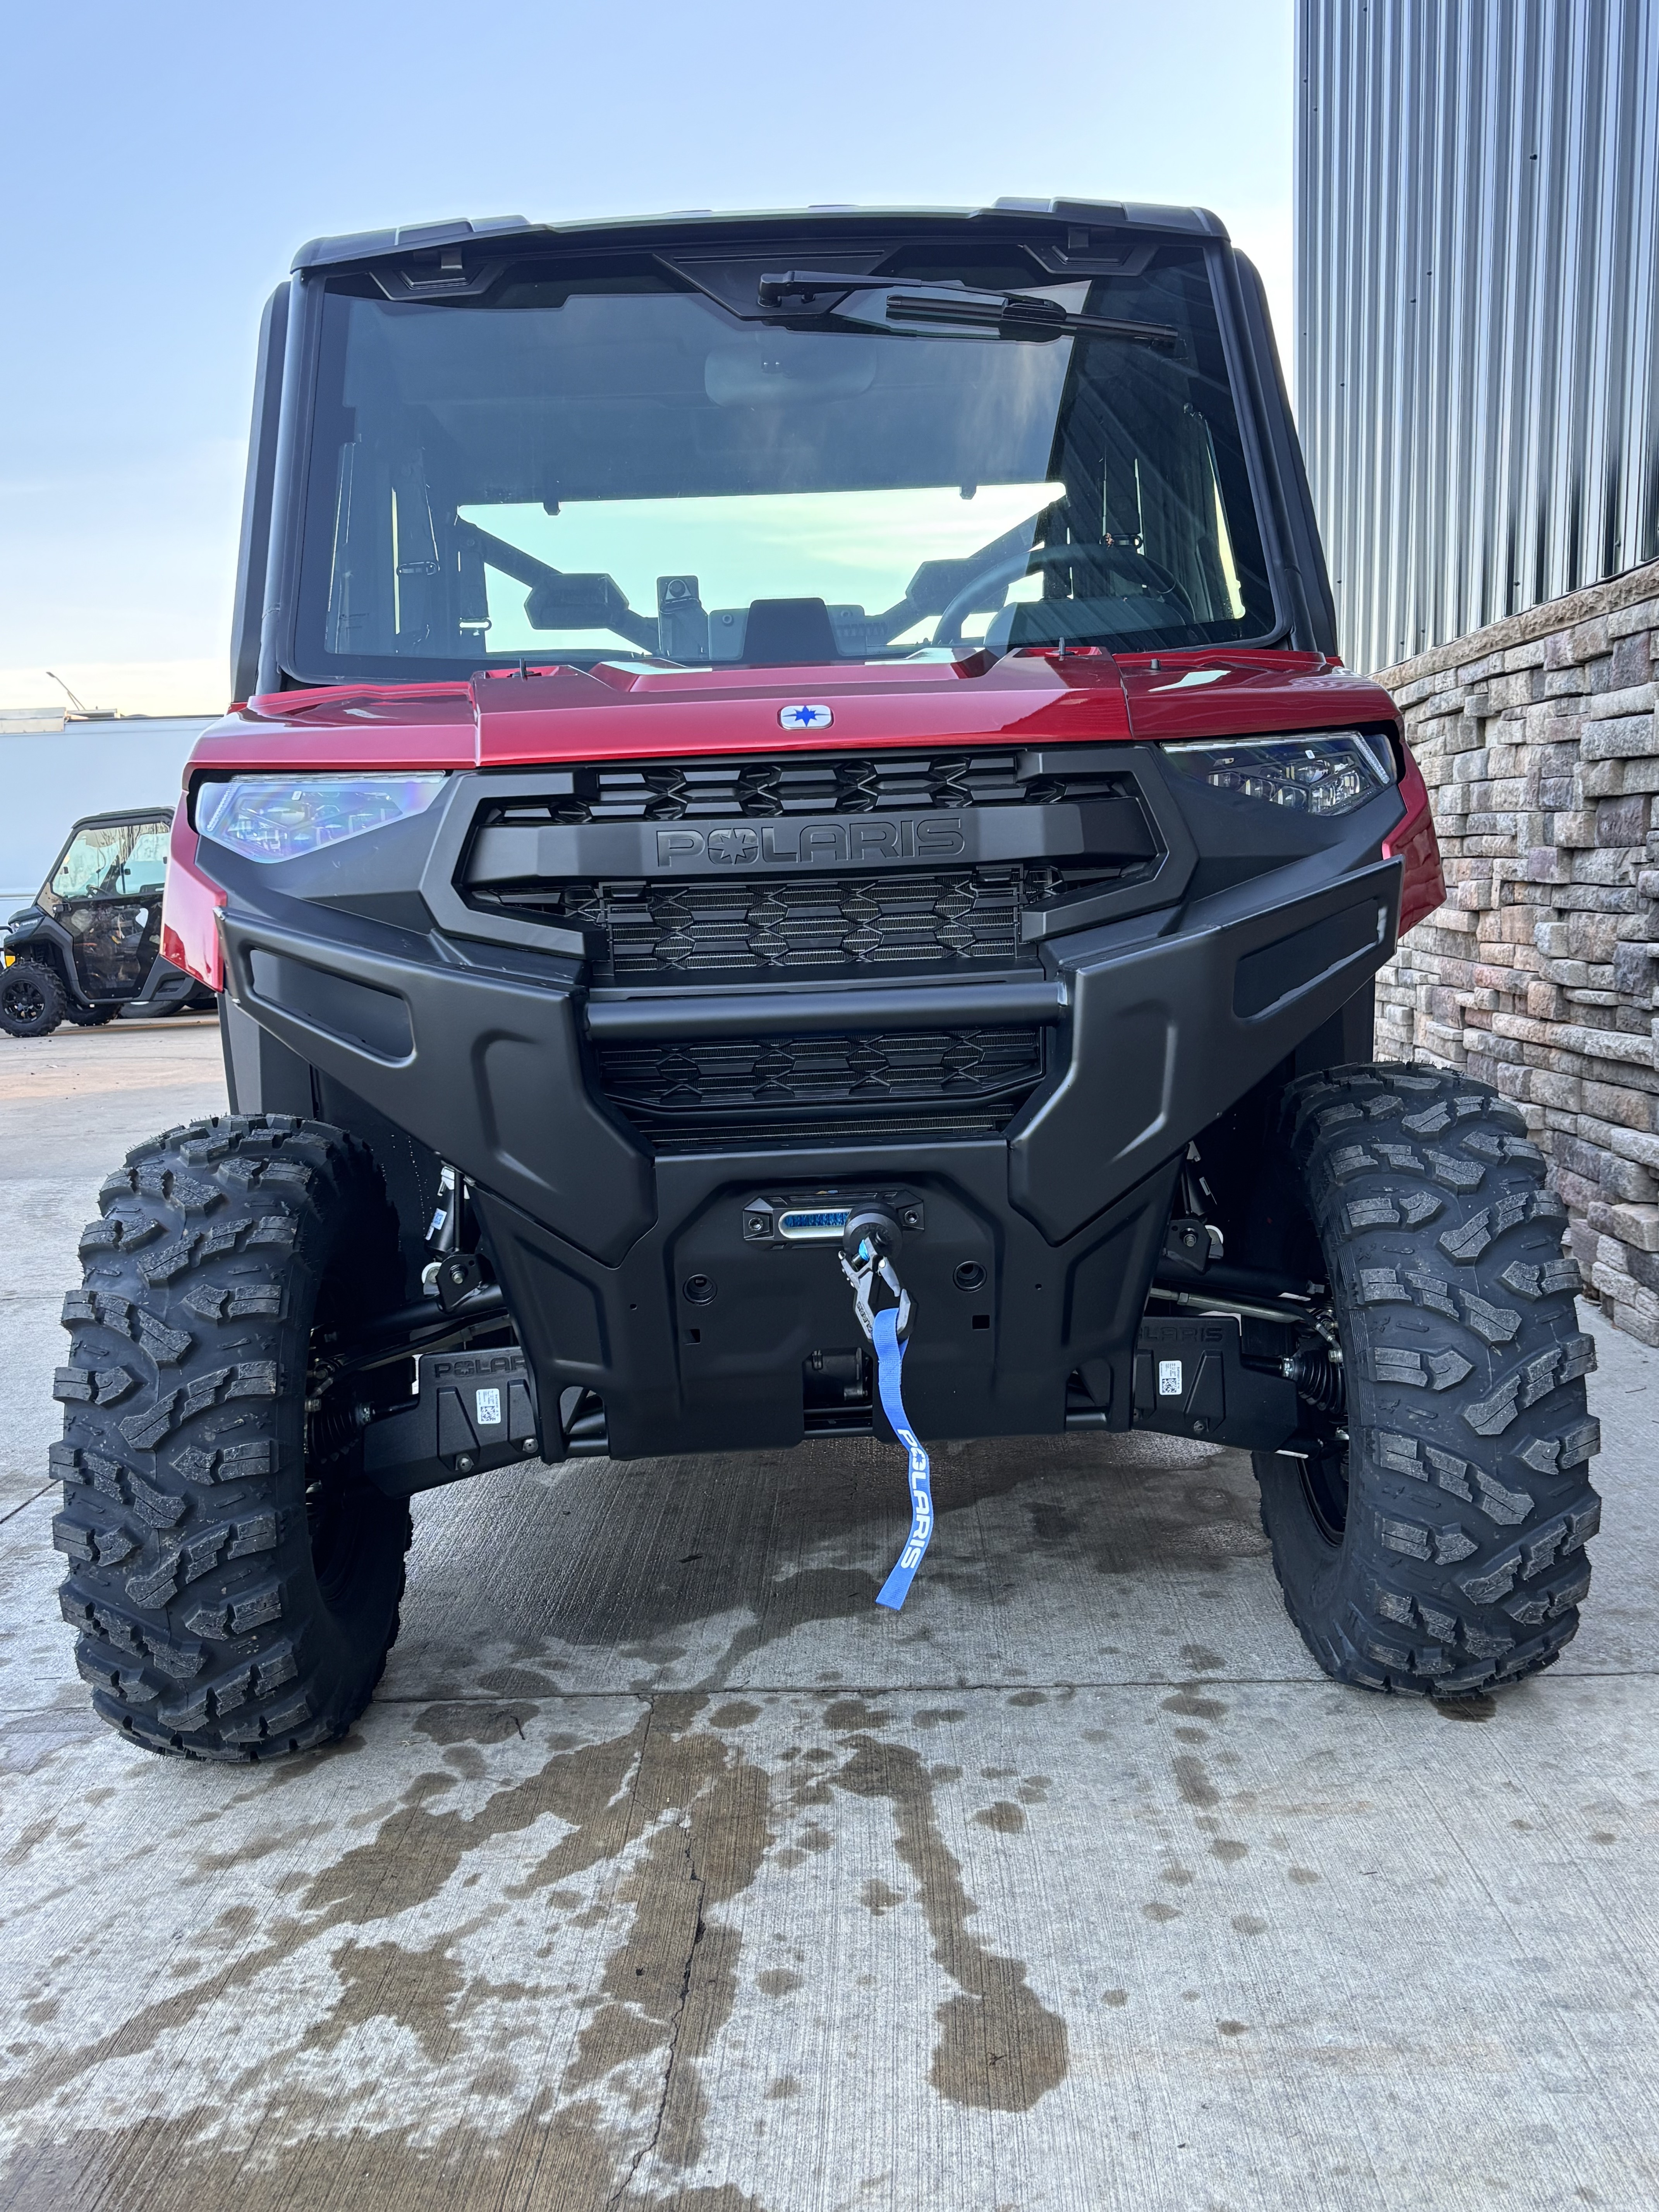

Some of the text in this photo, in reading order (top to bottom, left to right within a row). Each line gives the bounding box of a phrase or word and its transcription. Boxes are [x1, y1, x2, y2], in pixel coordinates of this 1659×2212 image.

[656, 818, 965, 867] POLARIS
[1140, 1326, 1223, 1342] LARIS
[897, 1428, 930, 1570] POLARIS
